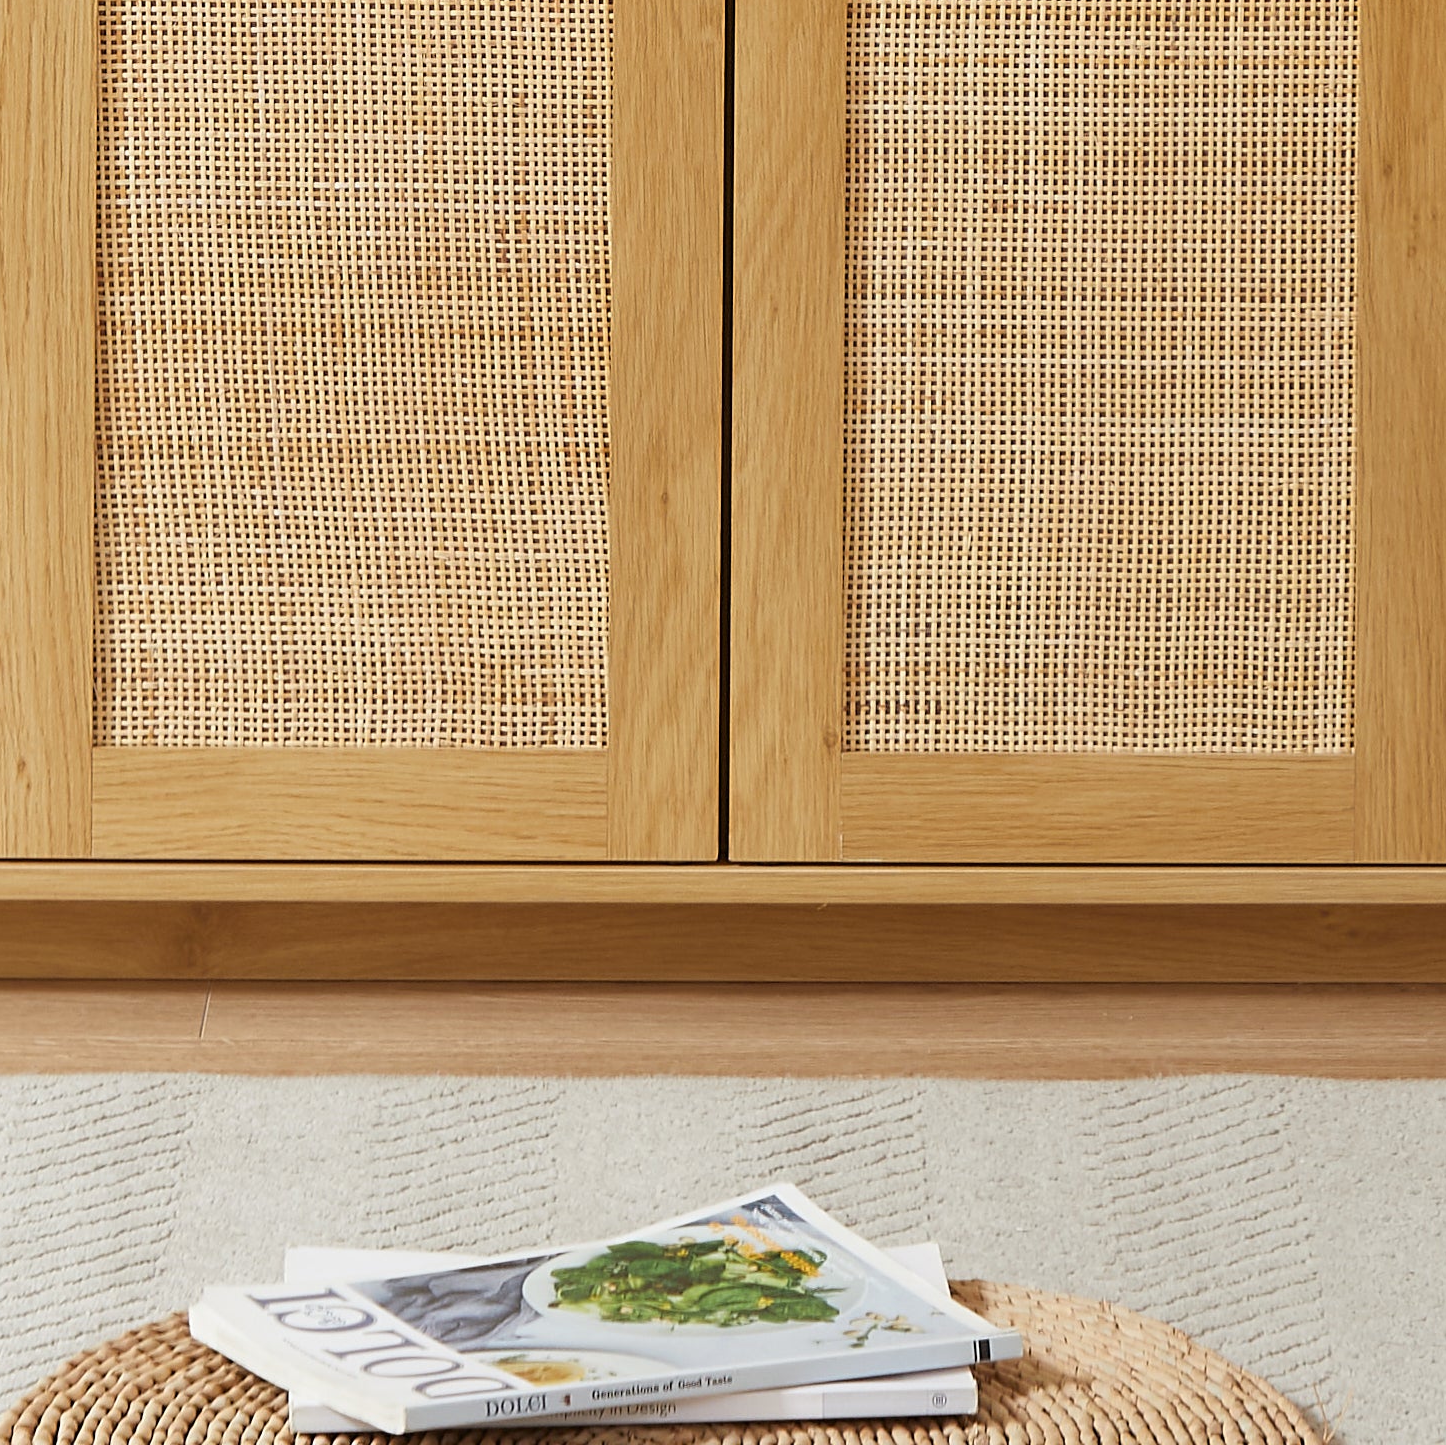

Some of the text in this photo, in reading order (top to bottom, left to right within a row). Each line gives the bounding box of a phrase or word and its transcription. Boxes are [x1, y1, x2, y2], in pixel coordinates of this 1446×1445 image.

[247, 1287, 517, 1399] DOLCI
[592, 1374, 733, 1401] Generations of Good Taste
[485, 1395, 548, 1417] DOLCI
